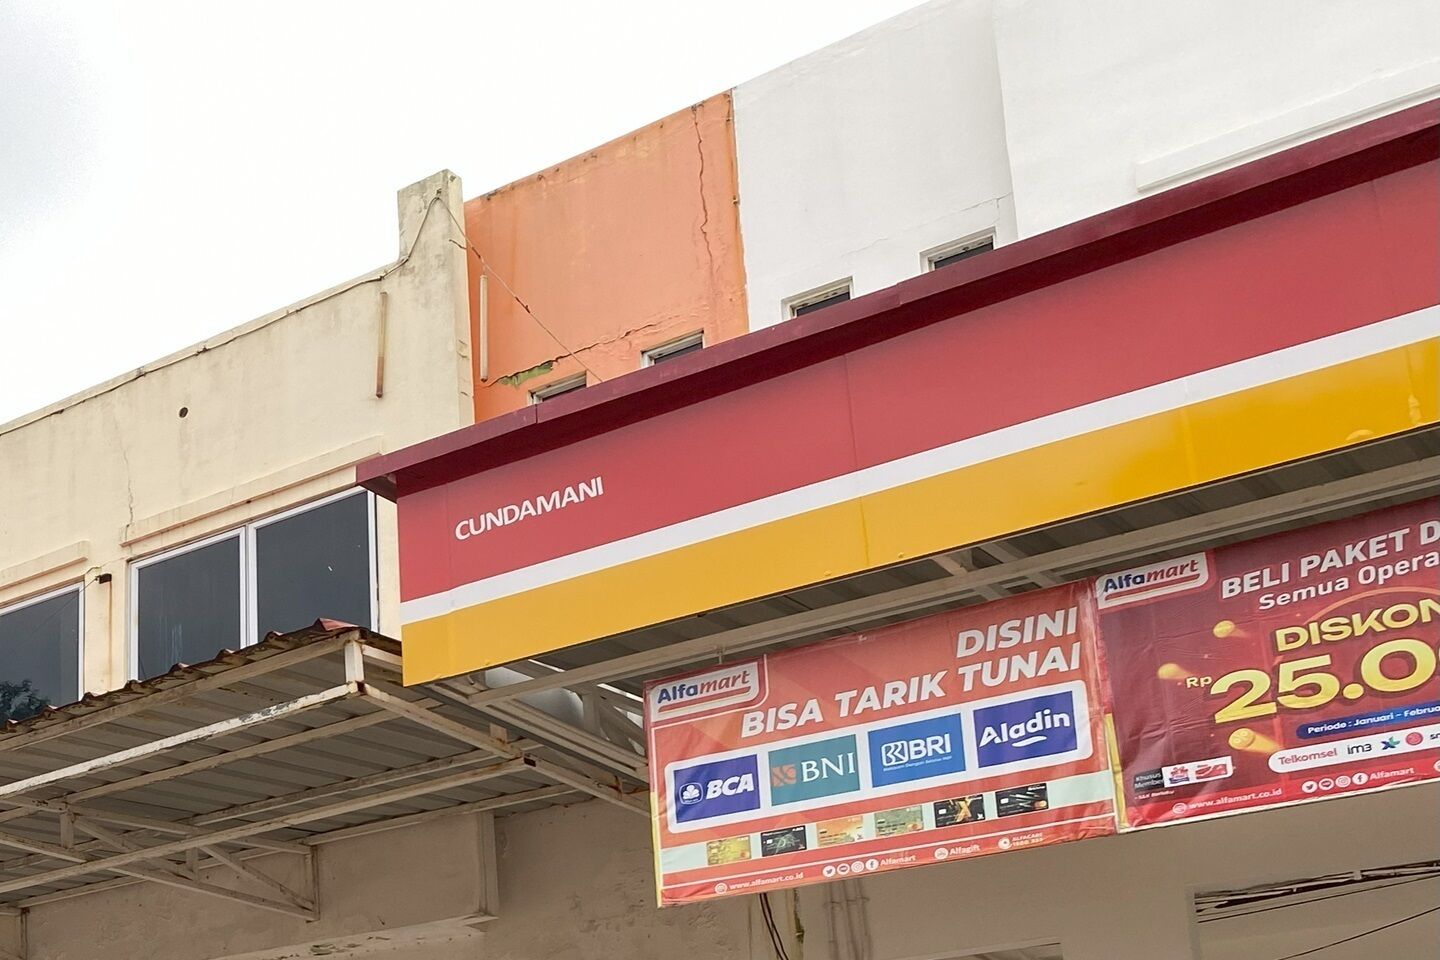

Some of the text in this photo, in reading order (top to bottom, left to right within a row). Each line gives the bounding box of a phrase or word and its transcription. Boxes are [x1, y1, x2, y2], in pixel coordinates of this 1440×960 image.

[455, 476, 604, 541] CUNDAMANI
[1103, 558, 1199, 594] Alfamart
[1222, 562, 1290, 599] BELI
[1300, 527, 1410, 579] PAKET
[1259, 551, 1440, 610] Semua Opera
[956, 606, 1078, 658] DISINI
[657, 667, 751, 704] Alfamart
[740, 642, 1081, 738] BISA TARIK TUNAI
[1186, 676, 1212, 689] Rp
[978, 708, 1070, 748] Aladin
[1307, 721, 1347, 734] Periode
[1353, 713, 1394, 726] Januari
[908, 733, 951, 760] BRI
[1278, 748, 1337, 766] Telkomsel
[1347, 743, 1372, 755] im3
[801, 752, 856, 783] BNI
[1369, 767, 1414, 781] Alfamart
[706, 773, 754, 800] BCA
[1188, 788, 1282, 809] www.alfamart.co.id
[880, 854, 916, 867] Alfamart
[949, 844, 980, 855] Alfagift
[729, 872, 804, 890] www.alfamart.co.id
